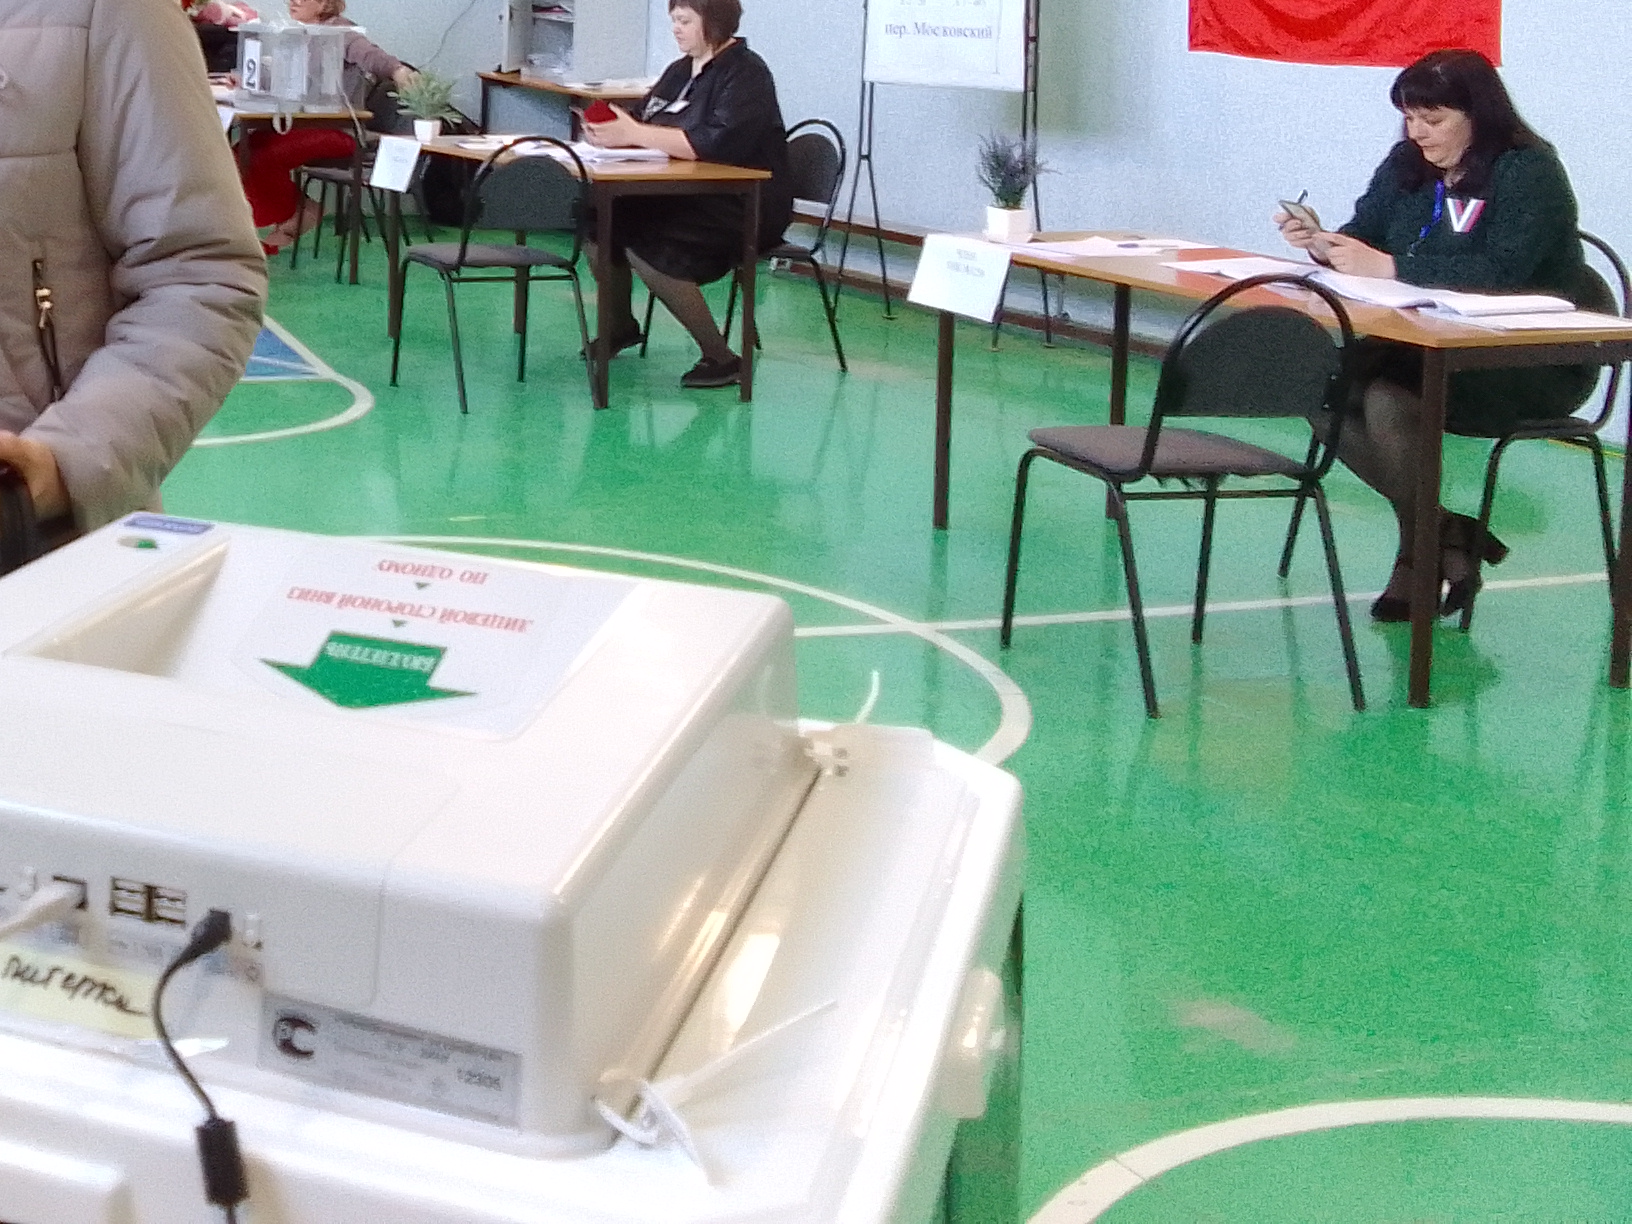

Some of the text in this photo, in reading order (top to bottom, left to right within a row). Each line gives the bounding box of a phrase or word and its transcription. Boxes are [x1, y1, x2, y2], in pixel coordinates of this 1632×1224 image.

[886, 23, 992, 39] пер. Московский
[376, 559, 490, 586] ПО ОДНОМУ
[285, 587, 533, 632] ЛИЦЕВОЙ СТОРОНОЙ ВНИЗ
